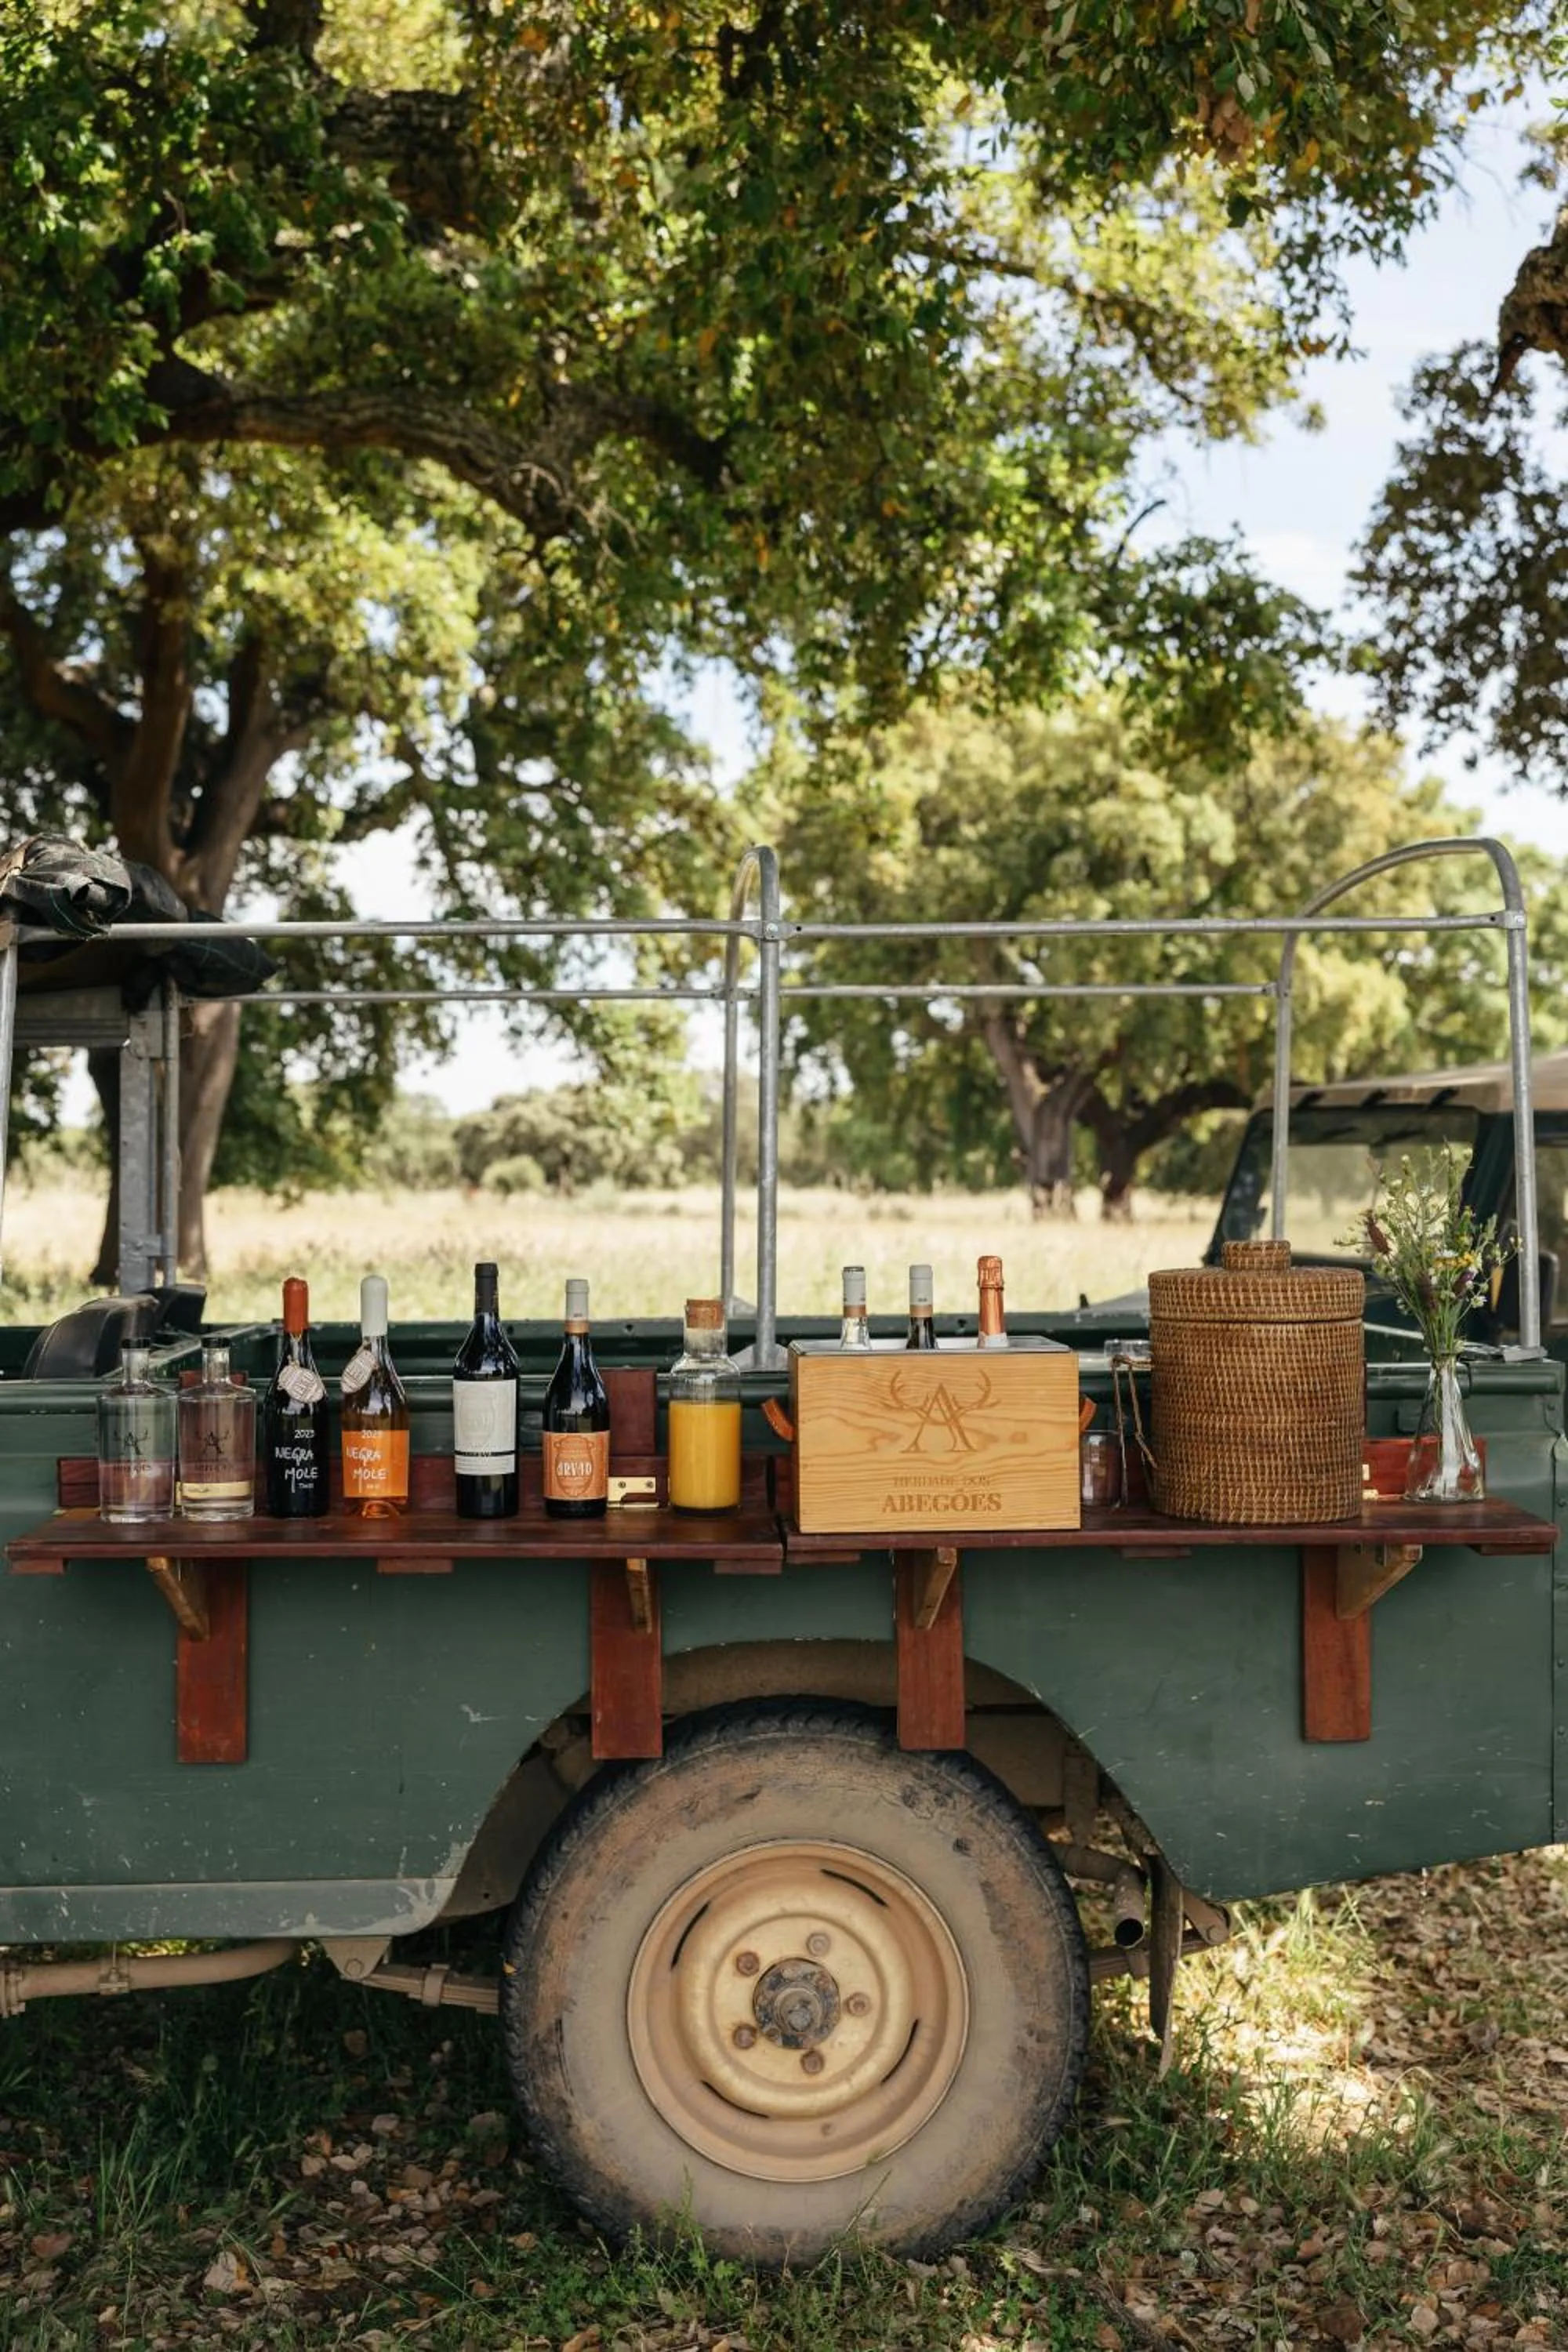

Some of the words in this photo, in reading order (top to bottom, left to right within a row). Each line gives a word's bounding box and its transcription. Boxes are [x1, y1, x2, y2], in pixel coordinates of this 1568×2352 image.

[274, 1446, 314, 1467] NEGRA
[285, 1467, 319, 1494] MOLE
[353, 1467, 387, 1494] MOLE
[881, 1488, 1002, 1513] ABEGÕES
